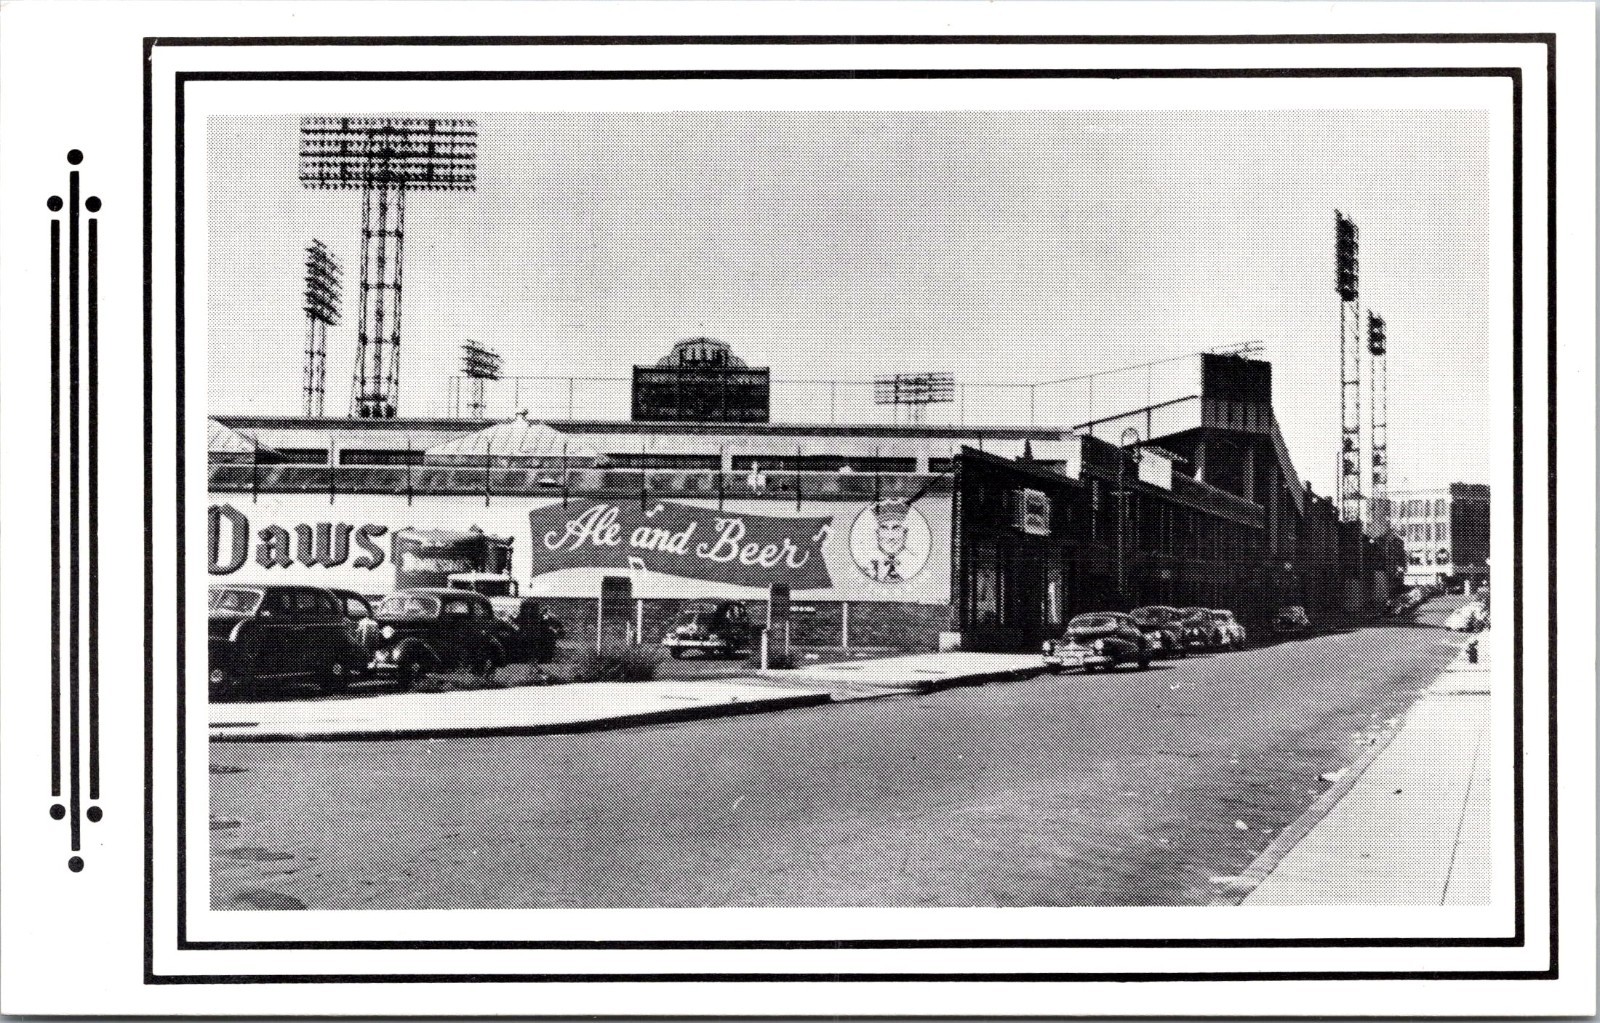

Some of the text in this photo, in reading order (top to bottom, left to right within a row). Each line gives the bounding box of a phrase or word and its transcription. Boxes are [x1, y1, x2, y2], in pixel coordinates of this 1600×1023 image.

[208, 503, 396, 576] Daws
[545, 504, 809, 569] Ale and Beer
